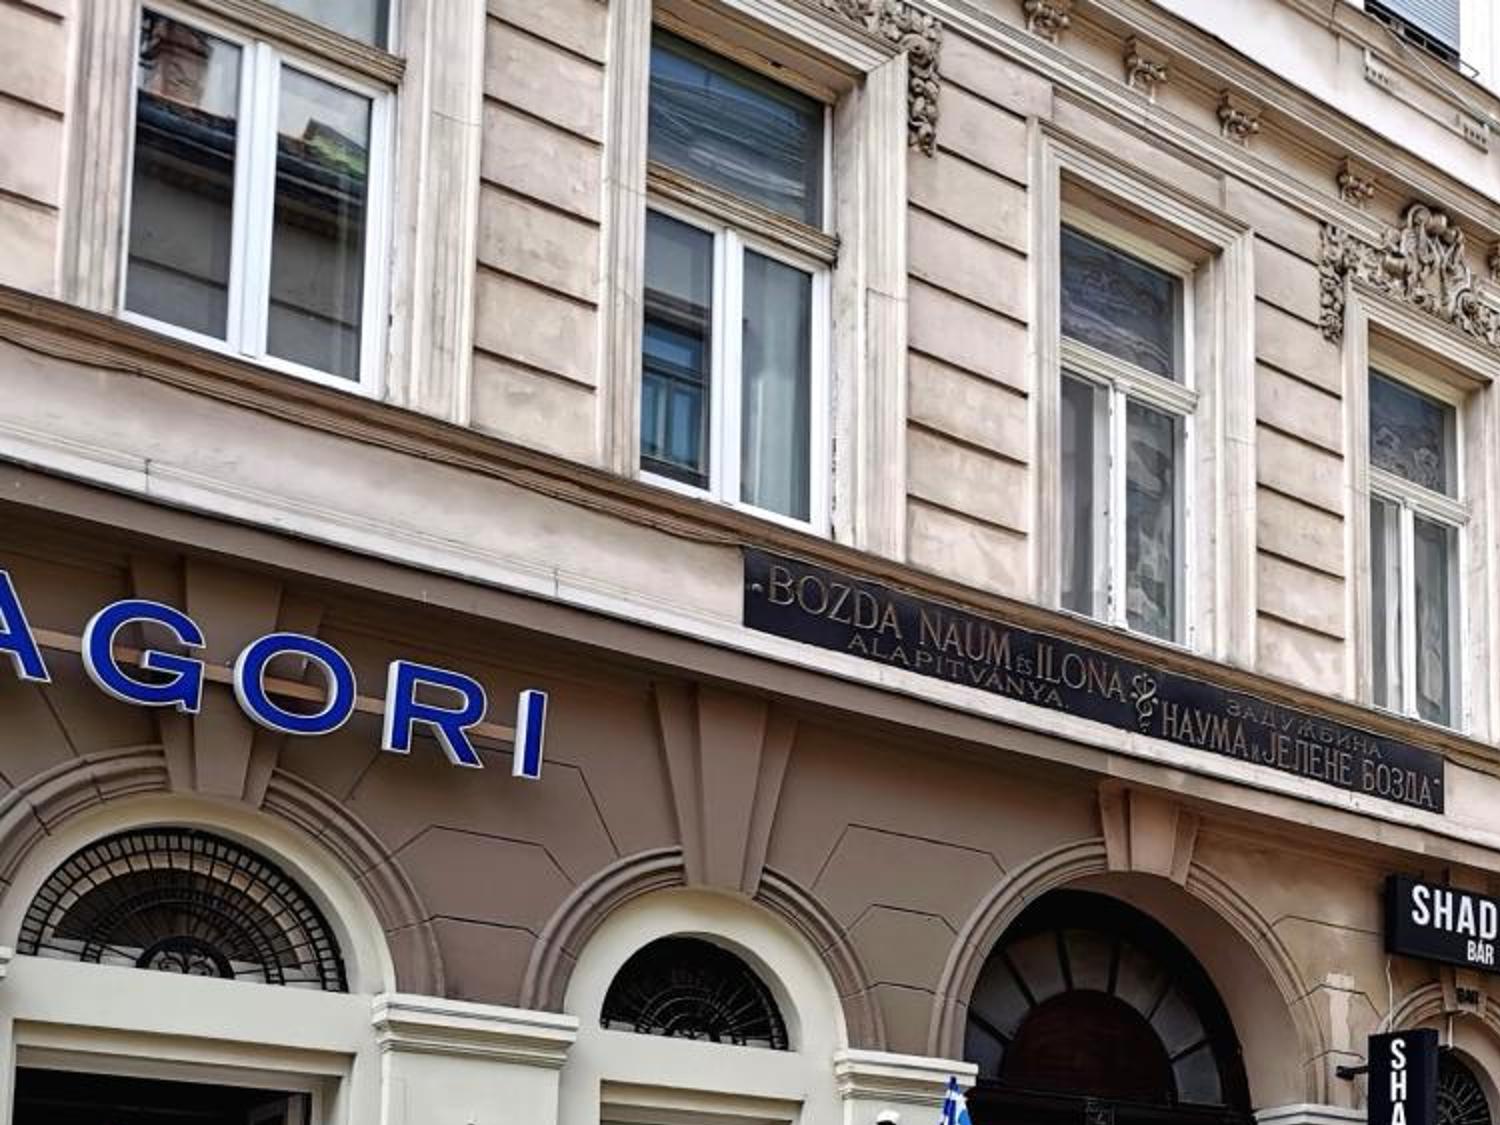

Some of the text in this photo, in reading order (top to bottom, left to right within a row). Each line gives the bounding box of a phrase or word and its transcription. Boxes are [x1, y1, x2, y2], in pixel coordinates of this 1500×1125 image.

[768, 565, 902, 640] BOZDA
[918, 608, 1013, 672] NAUM
[1035, 641, 1127, 703] ILONA
[1466, 939, 1495, 966] BÁR
